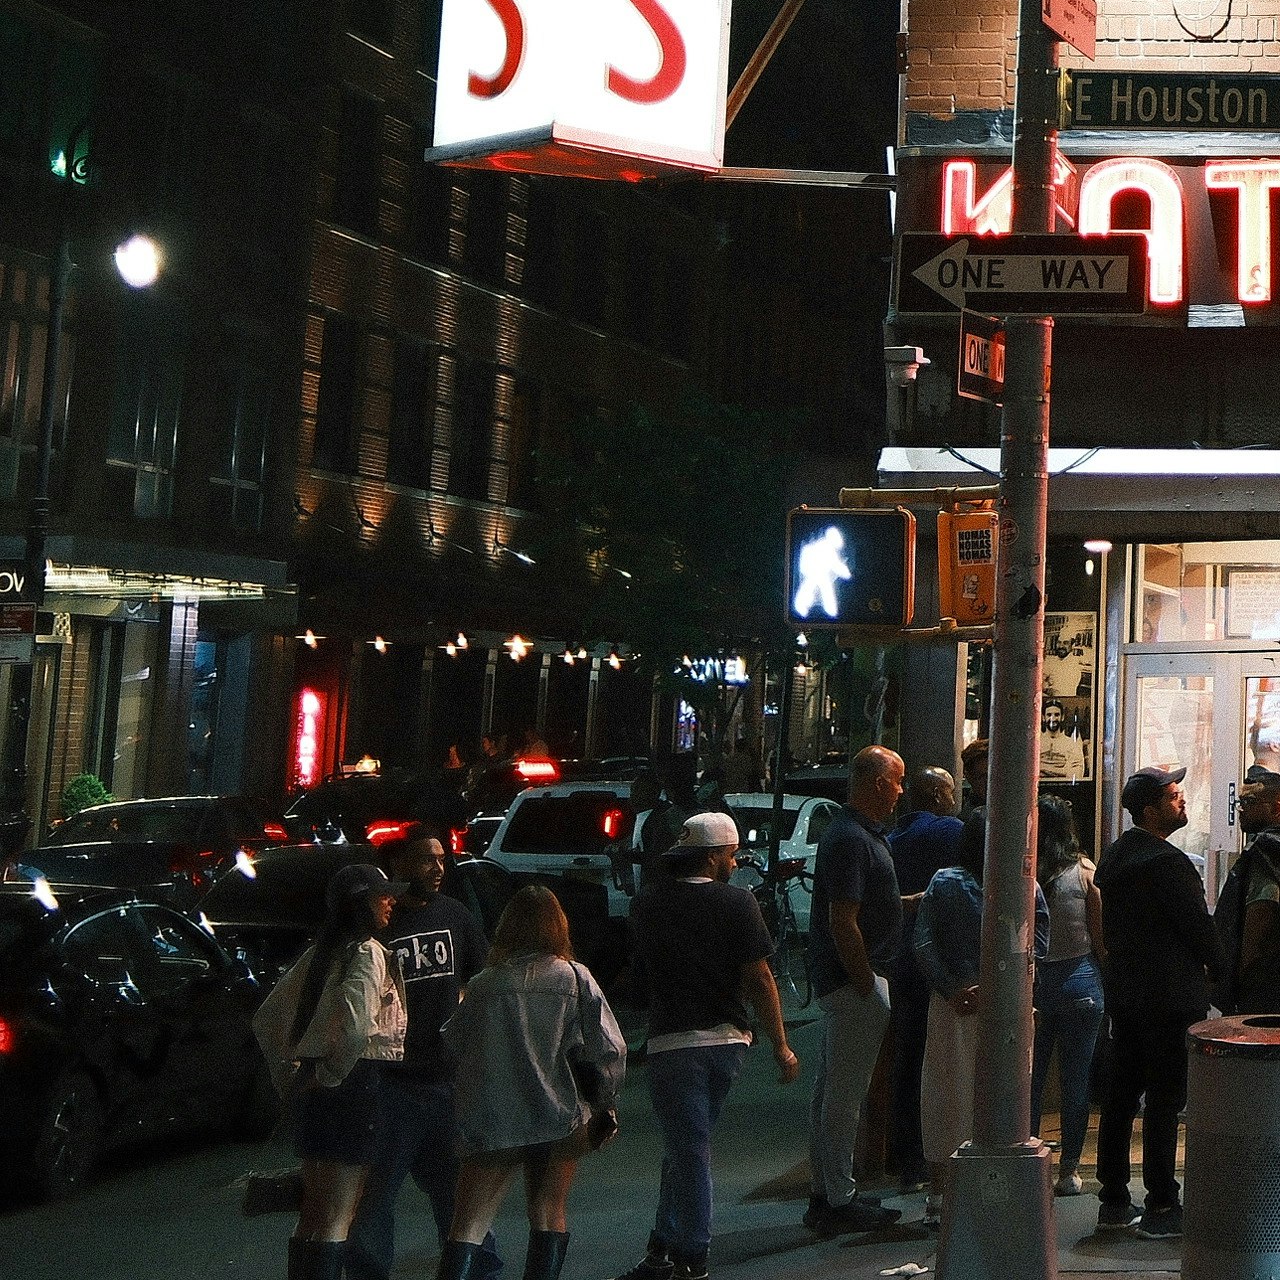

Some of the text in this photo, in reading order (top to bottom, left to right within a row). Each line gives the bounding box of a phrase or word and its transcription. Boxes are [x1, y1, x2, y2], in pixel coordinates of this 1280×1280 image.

[1075, 78, 1092, 121] E
[1111, 79, 1268, 123] Houston
[937, 259, 1115, 289] ONE WAY
